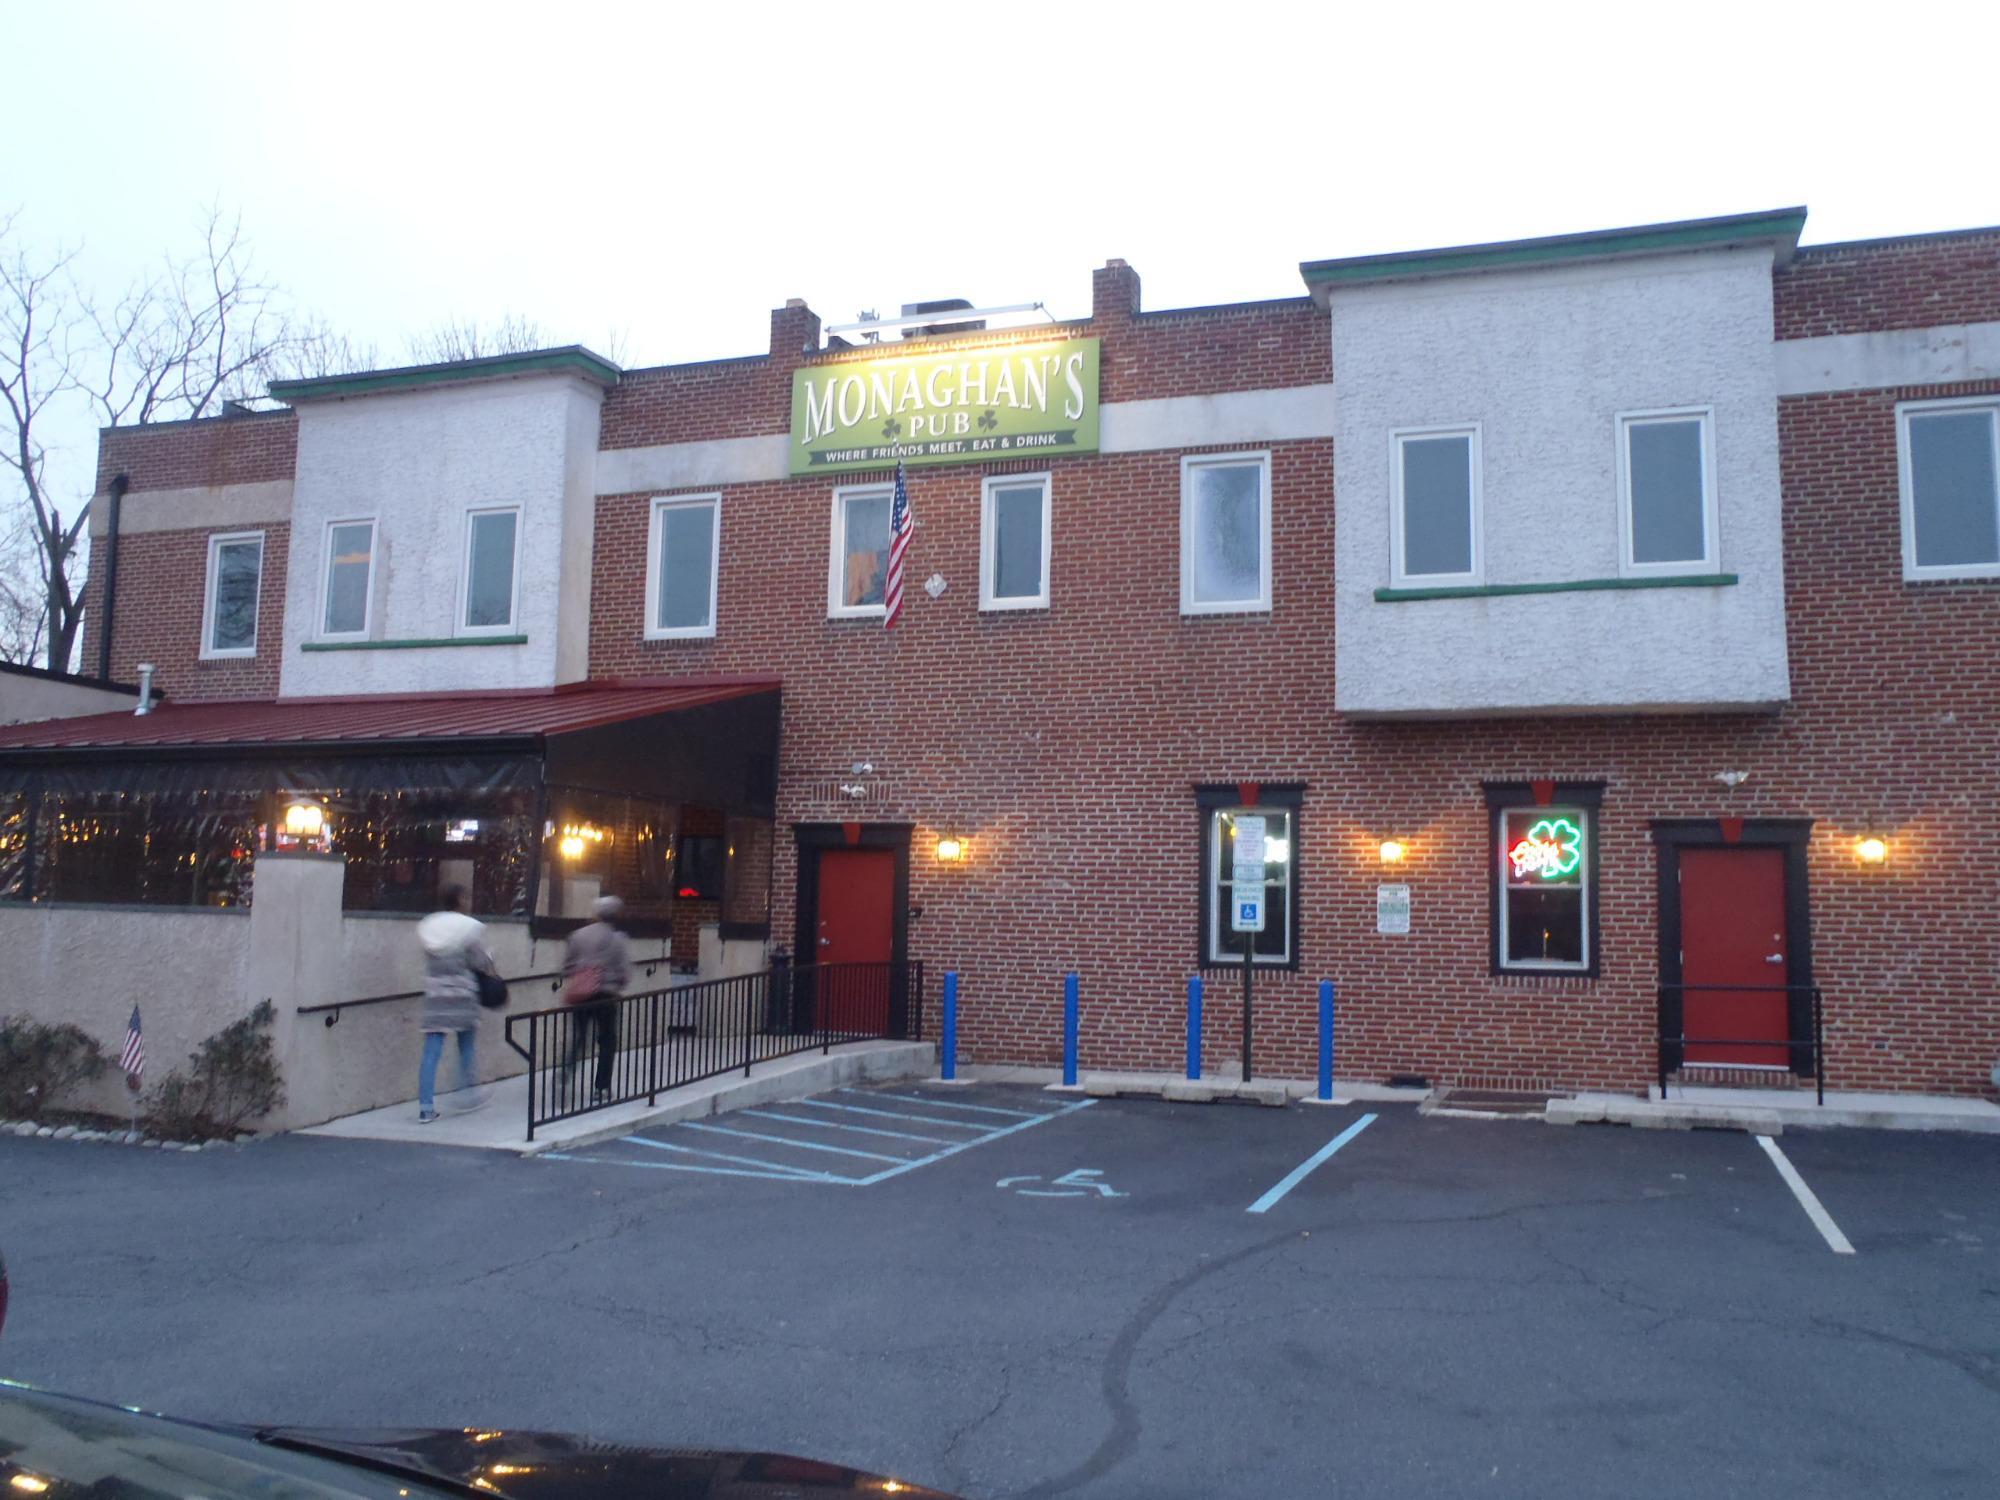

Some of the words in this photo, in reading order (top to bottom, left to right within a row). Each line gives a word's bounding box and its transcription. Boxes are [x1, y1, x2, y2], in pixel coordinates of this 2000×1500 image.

[801, 351, 1084, 445] MONAGHAN'S
[909, 412, 970, 438] PUB
[826, 448, 868, 463] WHERE
[872, 444, 923, 459] FRIENDS
[929, 440, 966, 455] MEET,
[973, 438, 996, 451] EAT
[1001, 437, 1010, 449] &
[1016, 433, 1057, 448] DRINK
